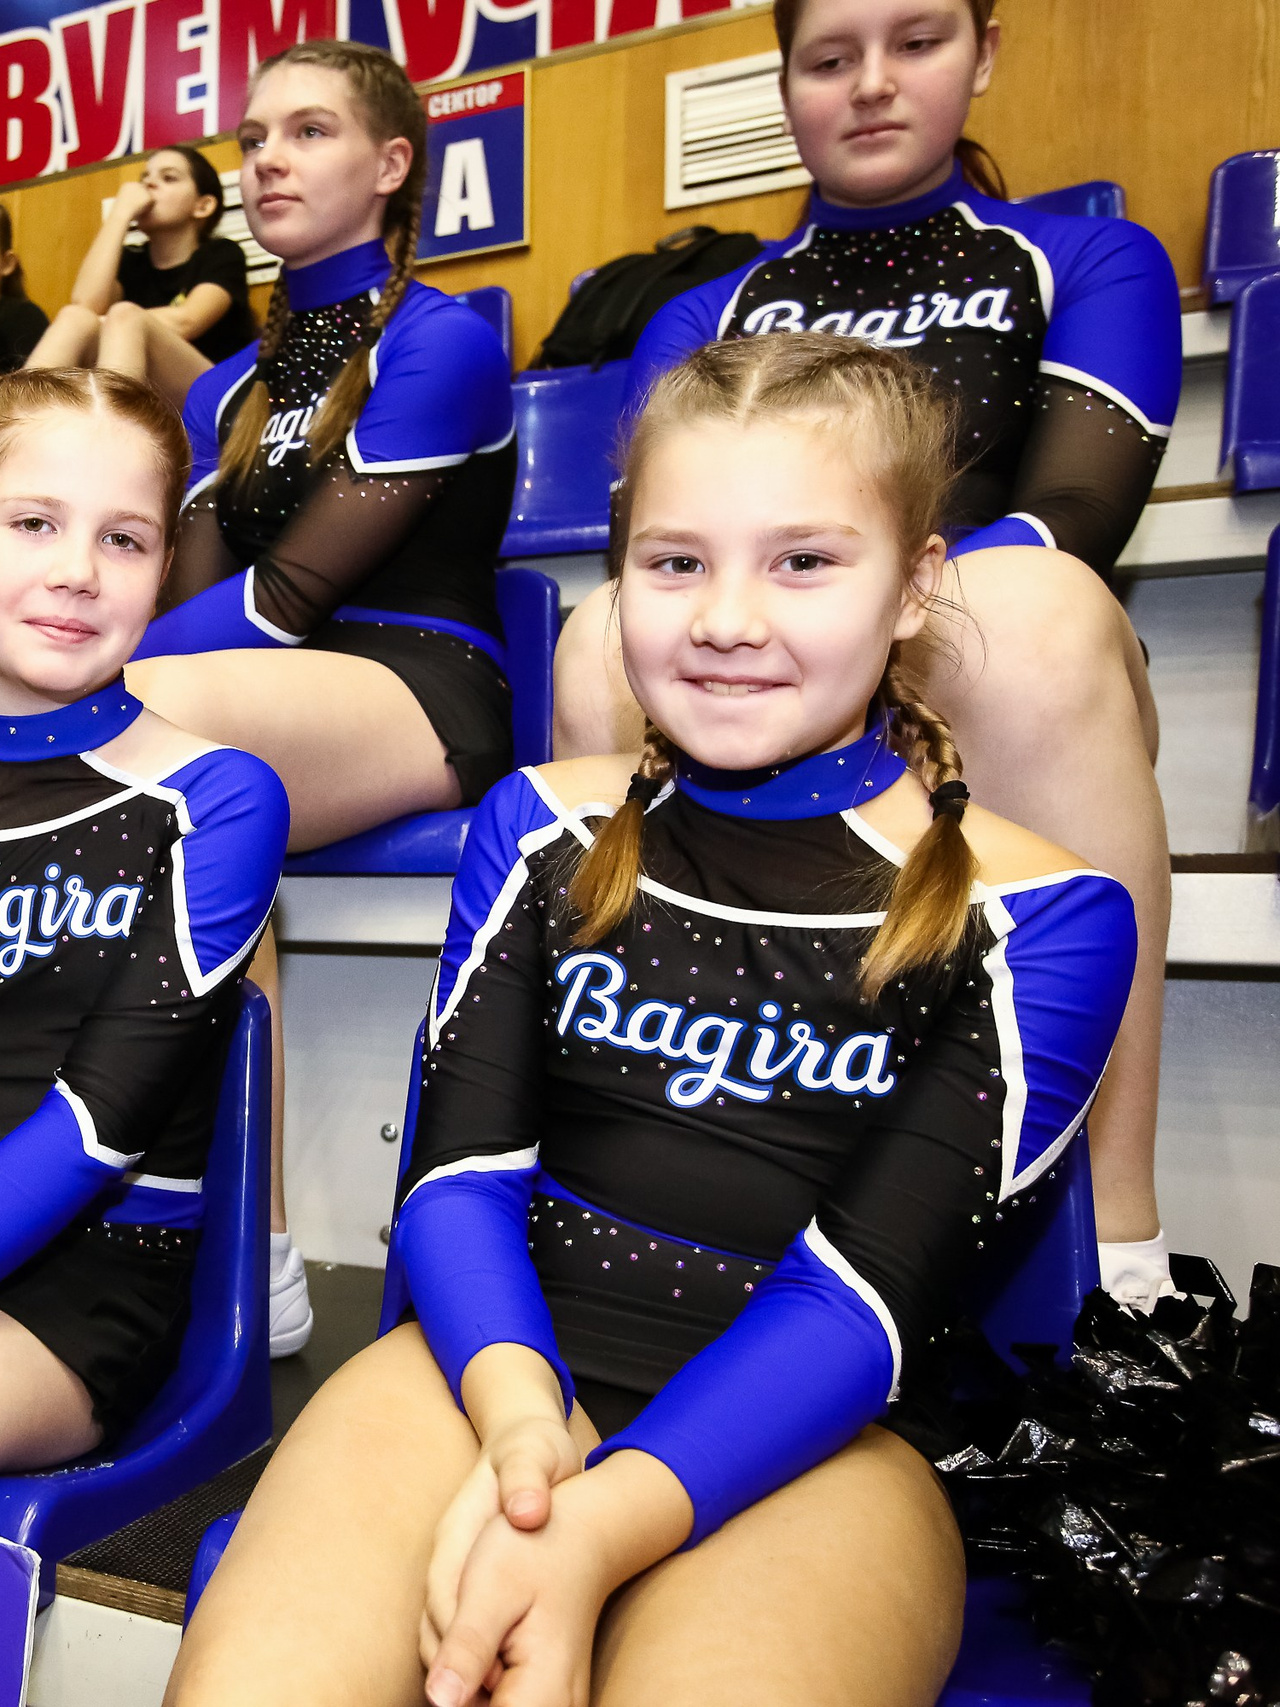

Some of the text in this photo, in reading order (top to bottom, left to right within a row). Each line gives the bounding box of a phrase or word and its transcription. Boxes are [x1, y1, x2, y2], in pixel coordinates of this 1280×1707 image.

[427, 80, 503, 118] СЕКТОР
[260, 392, 326, 467] agi
[554, 951, 897, 1108] Bagira
